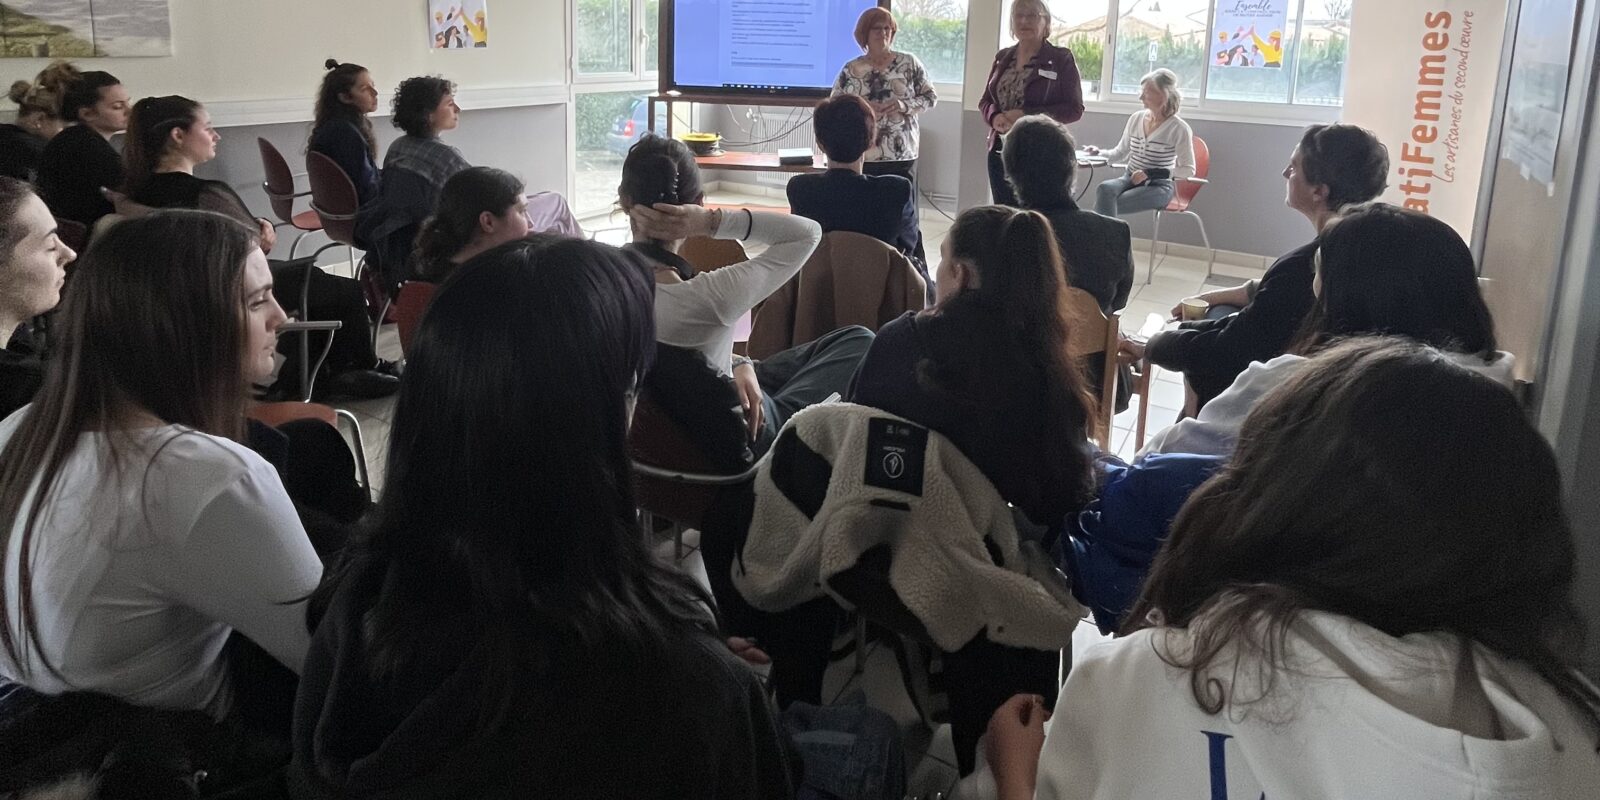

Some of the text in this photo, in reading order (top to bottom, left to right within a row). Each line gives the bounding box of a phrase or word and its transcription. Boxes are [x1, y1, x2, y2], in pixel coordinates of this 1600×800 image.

[1234, 0, 1272, 11] Ensemble
[1398, 11, 1452, 214] atiFemmes
[1431, 10, 1474, 183] Les artisanes du second œuvre
